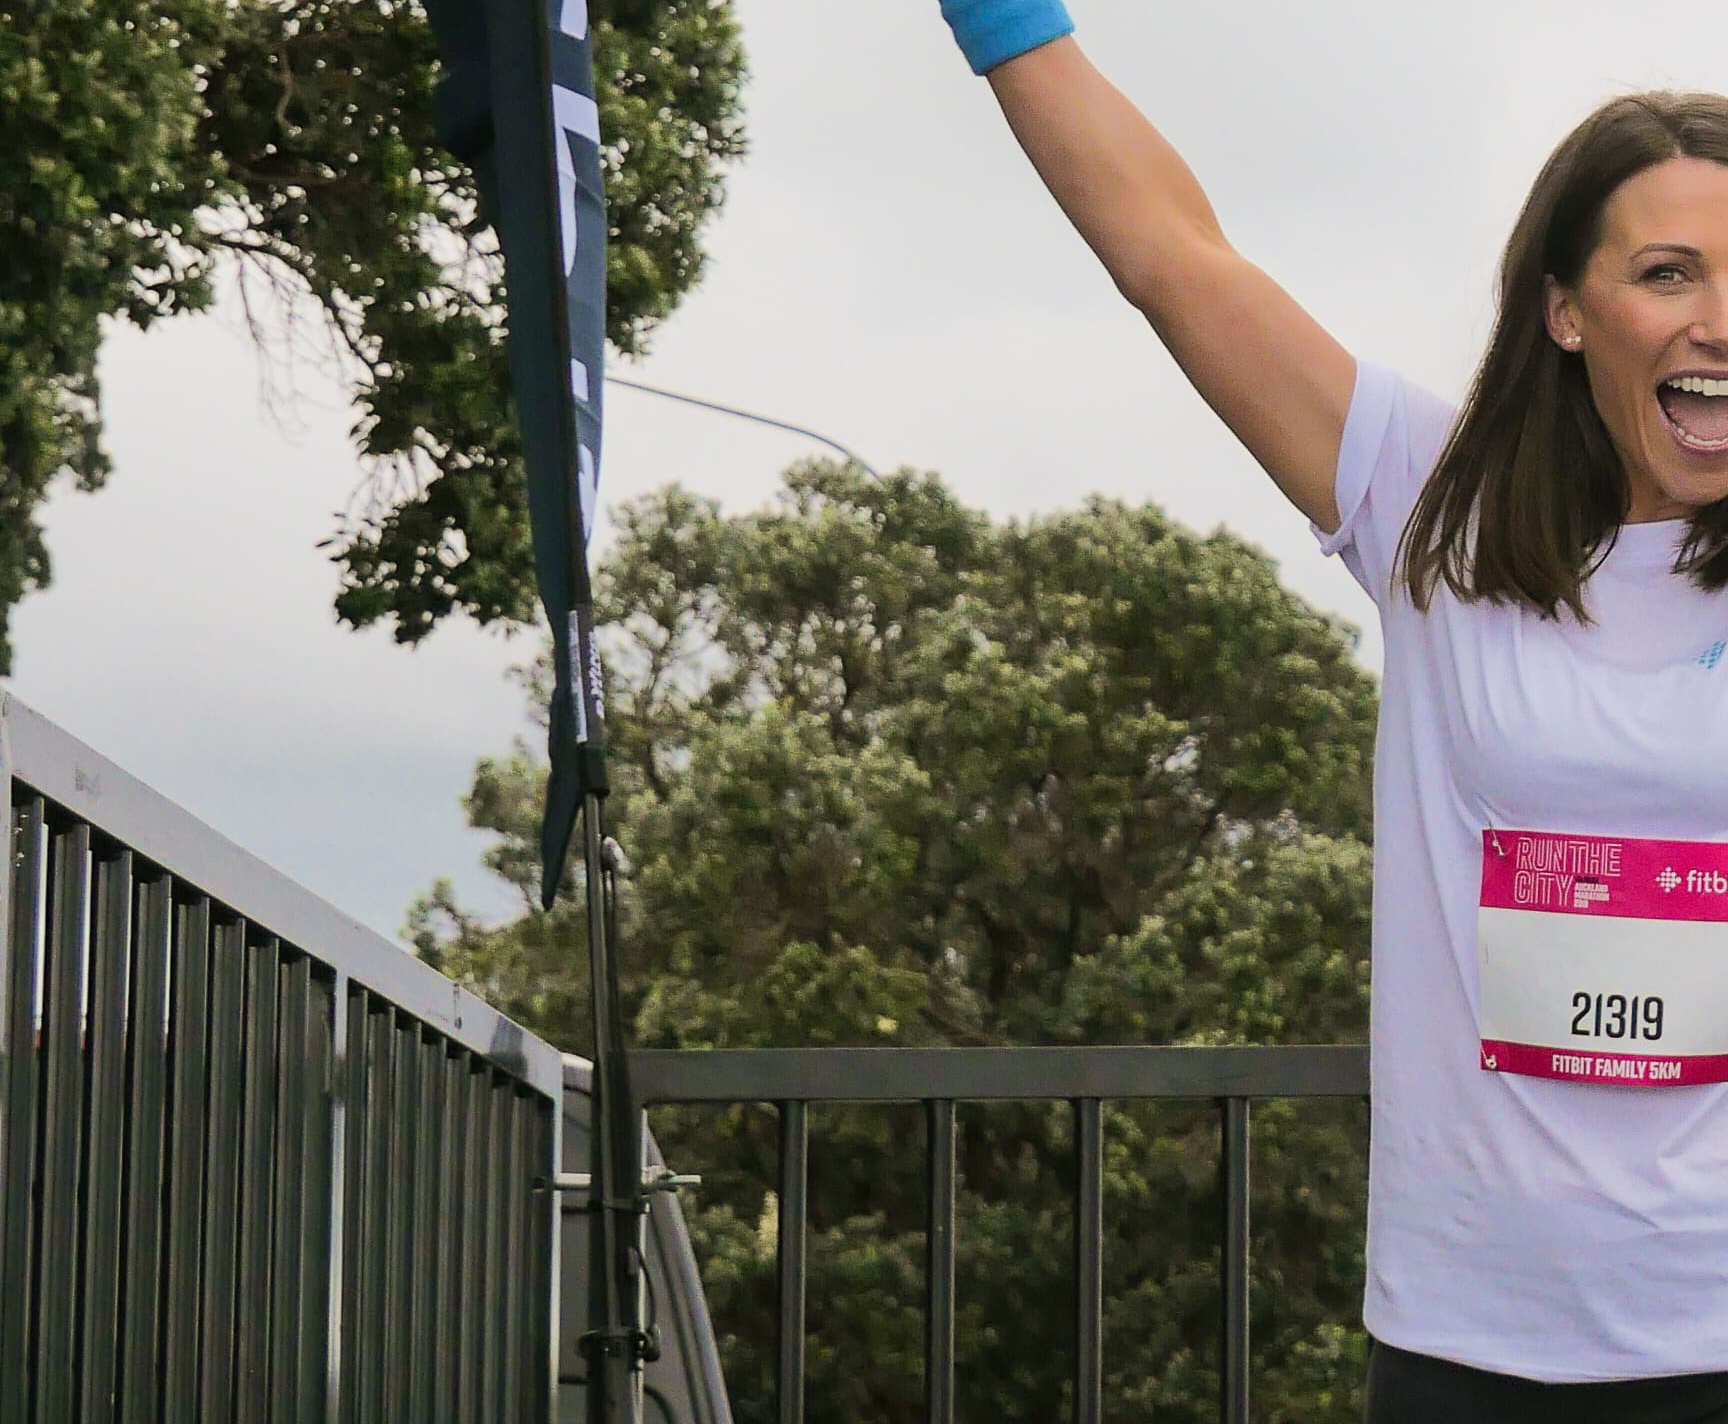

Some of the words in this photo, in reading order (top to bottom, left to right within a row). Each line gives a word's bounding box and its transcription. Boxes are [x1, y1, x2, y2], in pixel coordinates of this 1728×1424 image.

[1513, 869, 1574, 907] CITY
[1570, 991, 1664, 1041] 21319
[1551, 1054, 1592, 1075] FITBIT
[1595, 1057, 1647, 1080] FAMILY
[1649, 1061, 1682, 1080] 5KM
